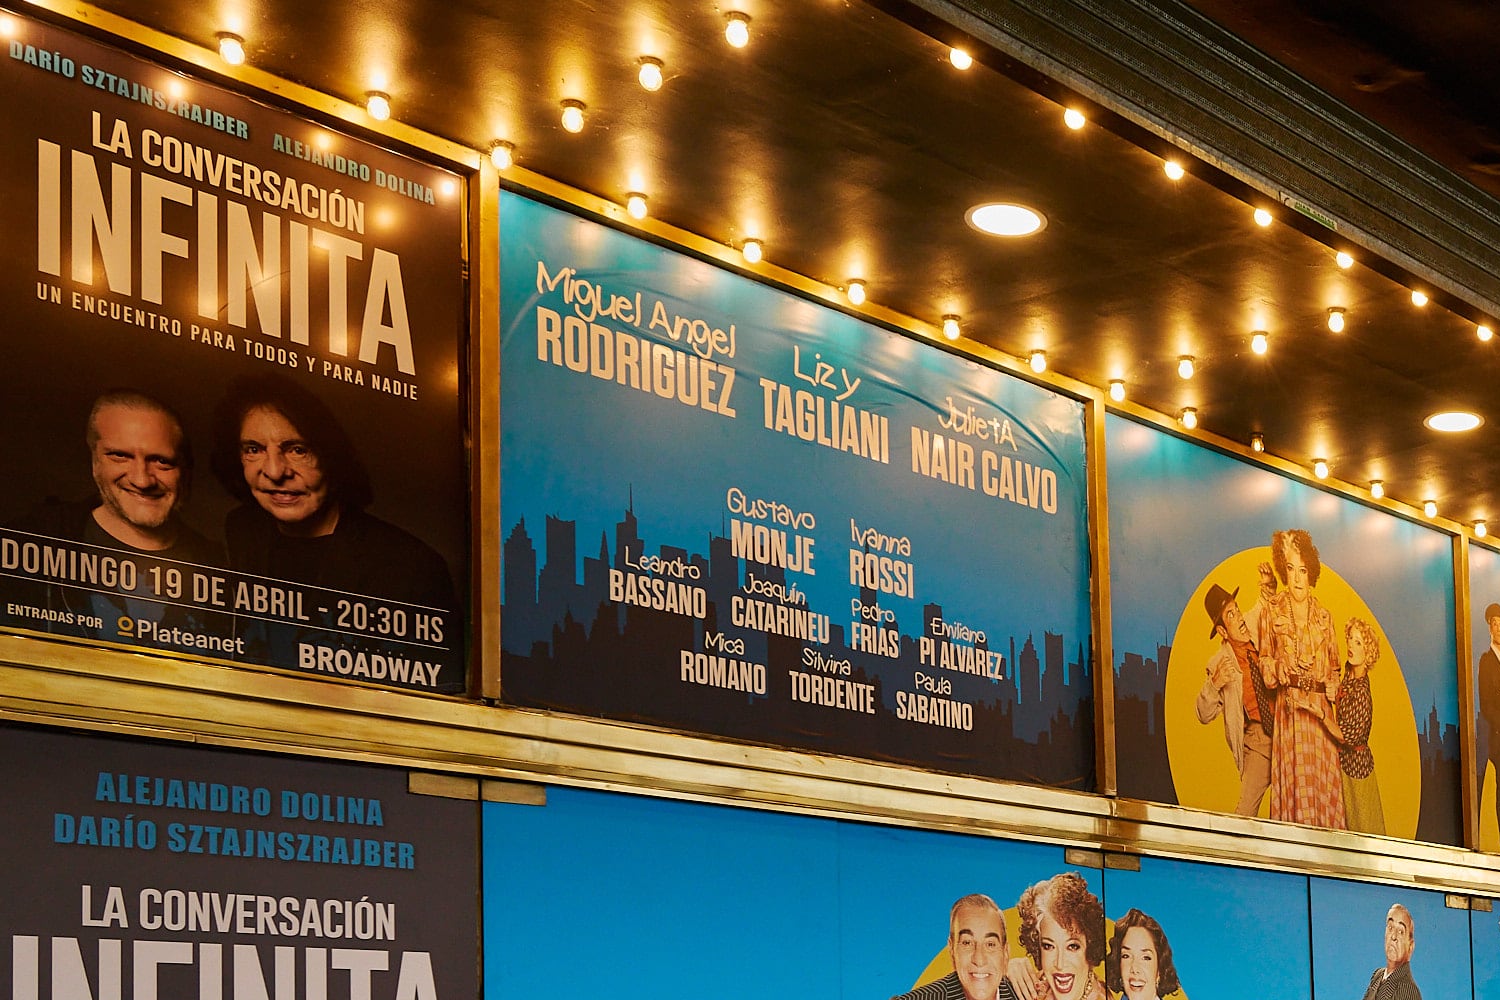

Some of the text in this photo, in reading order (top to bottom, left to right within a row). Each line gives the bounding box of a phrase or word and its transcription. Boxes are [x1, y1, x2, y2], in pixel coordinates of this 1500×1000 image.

[8, 40, 435, 205] DARÍO SZTAJNSZRAJBER ALEJANDRO DOLINA
[92, 110, 365, 235] LA CONVERSACIÓN
[37, 137, 416, 377] INFINITA
[536, 260, 736, 360] Miguel Angel
[36, 281, 419, 401] UN ENCUENTRO PARA TODOS Y PARA NADIE
[536, 305, 736, 419] RODRIGUEZ
[793, 344, 861, 401] Lizy
[760, 377, 890, 465] TAGLIANI
[911, 427, 1057, 515] NAIR CALVO
[726, 487, 816, 531] Gustavo
[730, 518, 815, 576] MONJE
[850, 518, 911, 557] Ivanna
[625, 546, 700, 580] Leandro
[849, 548, 914, 599] ROSSI
[1, 537, 137, 592] DOMINGO
[149, 566, 183, 599] 19
[193, 573, 226, 607] DE
[235, 581, 310, 621] ABRIL
[337, 599, 407, 638] 20:30
[415, 613, 445, 643] HS
[609, 568, 706, 620] BASSANO
[743, 572, 806, 606] Joaquín
[851, 598, 895, 624] Pedro
[7, 603, 103, 630] ENTRADAS POR
[731, 595, 829, 645] CATARINEU
[851, 622, 899, 659] FRIAS
[930, 617, 986, 645] Emiliano
[298, 642, 441, 687] BROADWAY
[704, 631, 745, 656] Mica
[802, 647, 852, 677] Silvina
[919, 636, 1003, 681] PI ALVAREZ
[681, 650, 766, 696] ROMANO
[789, 670, 875, 715] TORDENTE
[914, 671, 952, 696] Paula
[896, 690, 973, 732] SABATINO
[95, 771, 384, 827] ALEJANDRO DOLINA
[54, 812, 415, 870] DARÍO SZTAJNSZRAJBER
[81, 884, 396, 941] LA CONVERSACIÓN
